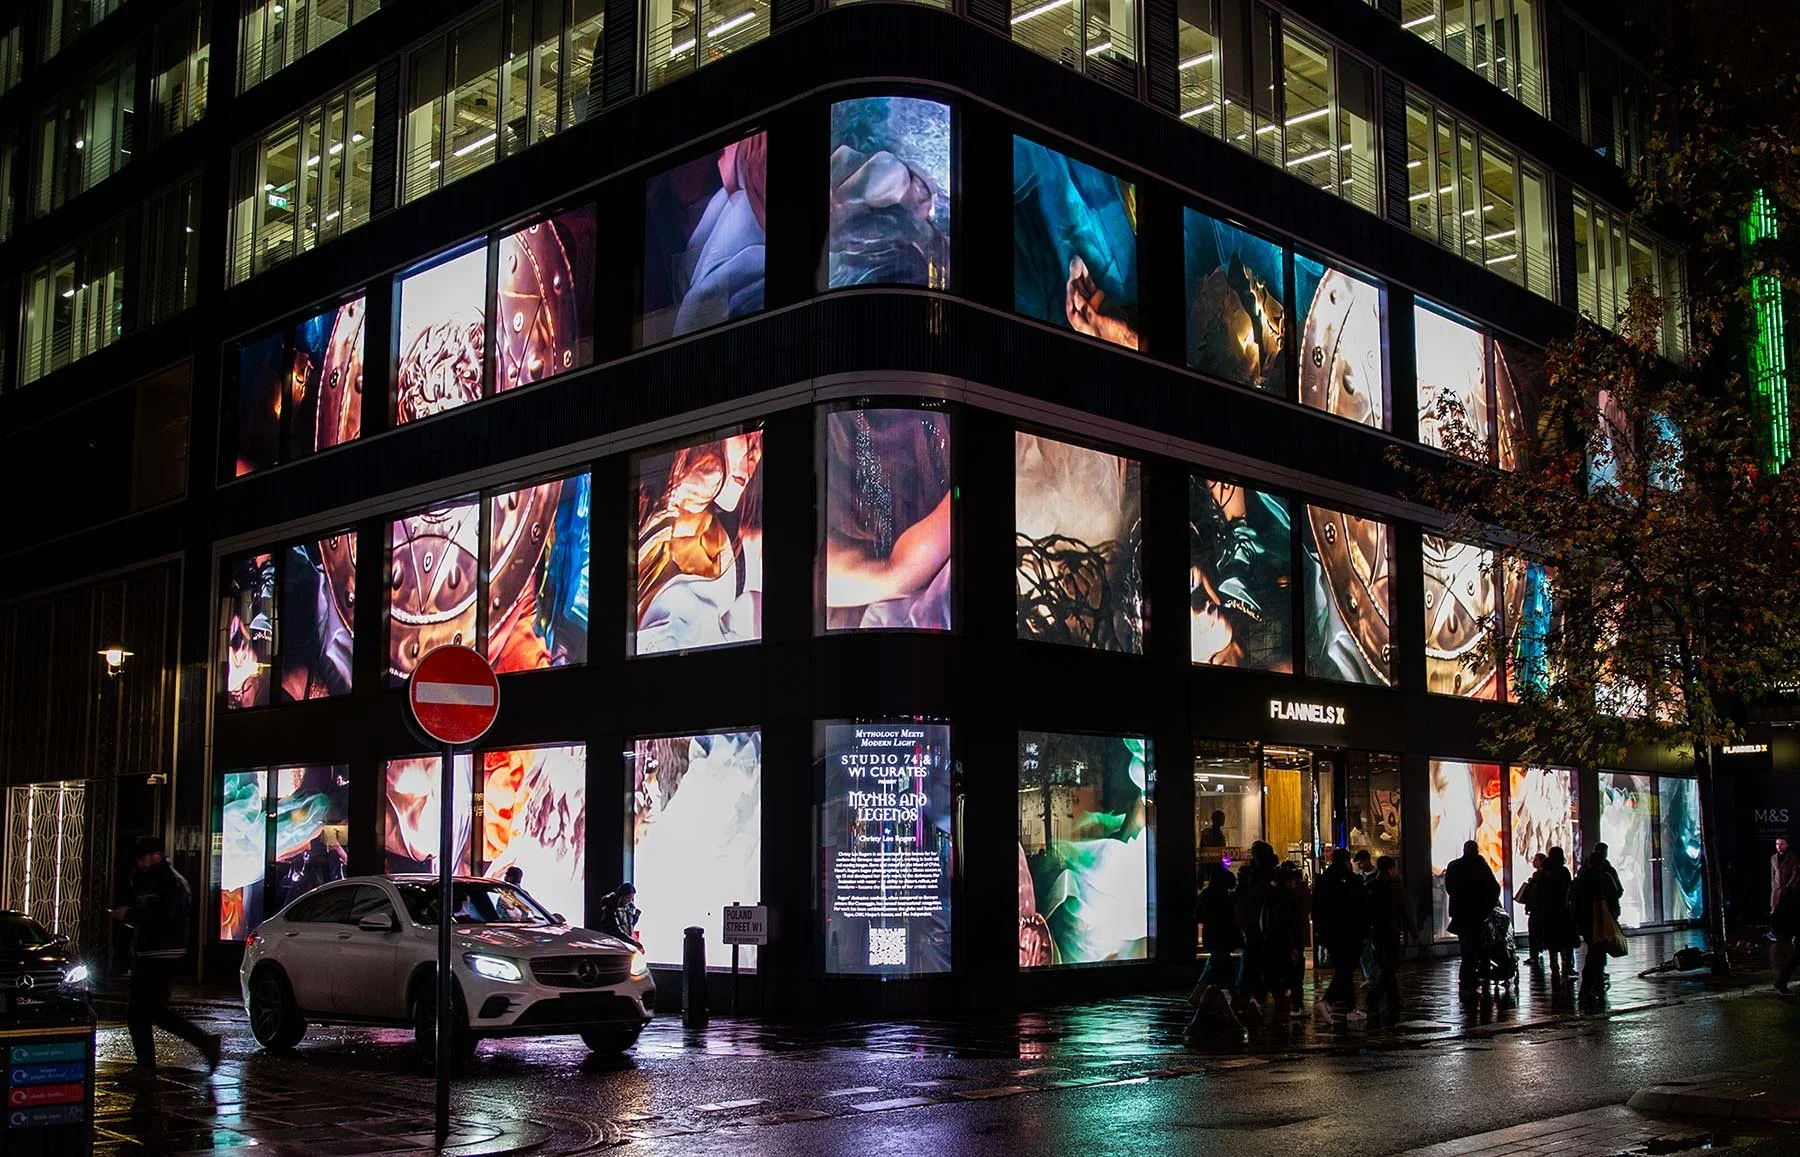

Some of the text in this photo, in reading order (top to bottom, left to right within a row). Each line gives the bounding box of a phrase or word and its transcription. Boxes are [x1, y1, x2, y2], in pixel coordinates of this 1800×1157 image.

[1270, 700, 1345, 725] FLANNELS X
[855, 729, 924, 738] MYTHOLOGY MEETS
[861, 739, 916, 747] MODERN LIGHT
[841, 754, 898, 765] STUDIO
[869, 766, 927, 778] CURATES
[1754, 808, 1789, 823] M&S
[726, 909, 753, 920] POLAND
[726, 922, 762, 932] STREET W1
